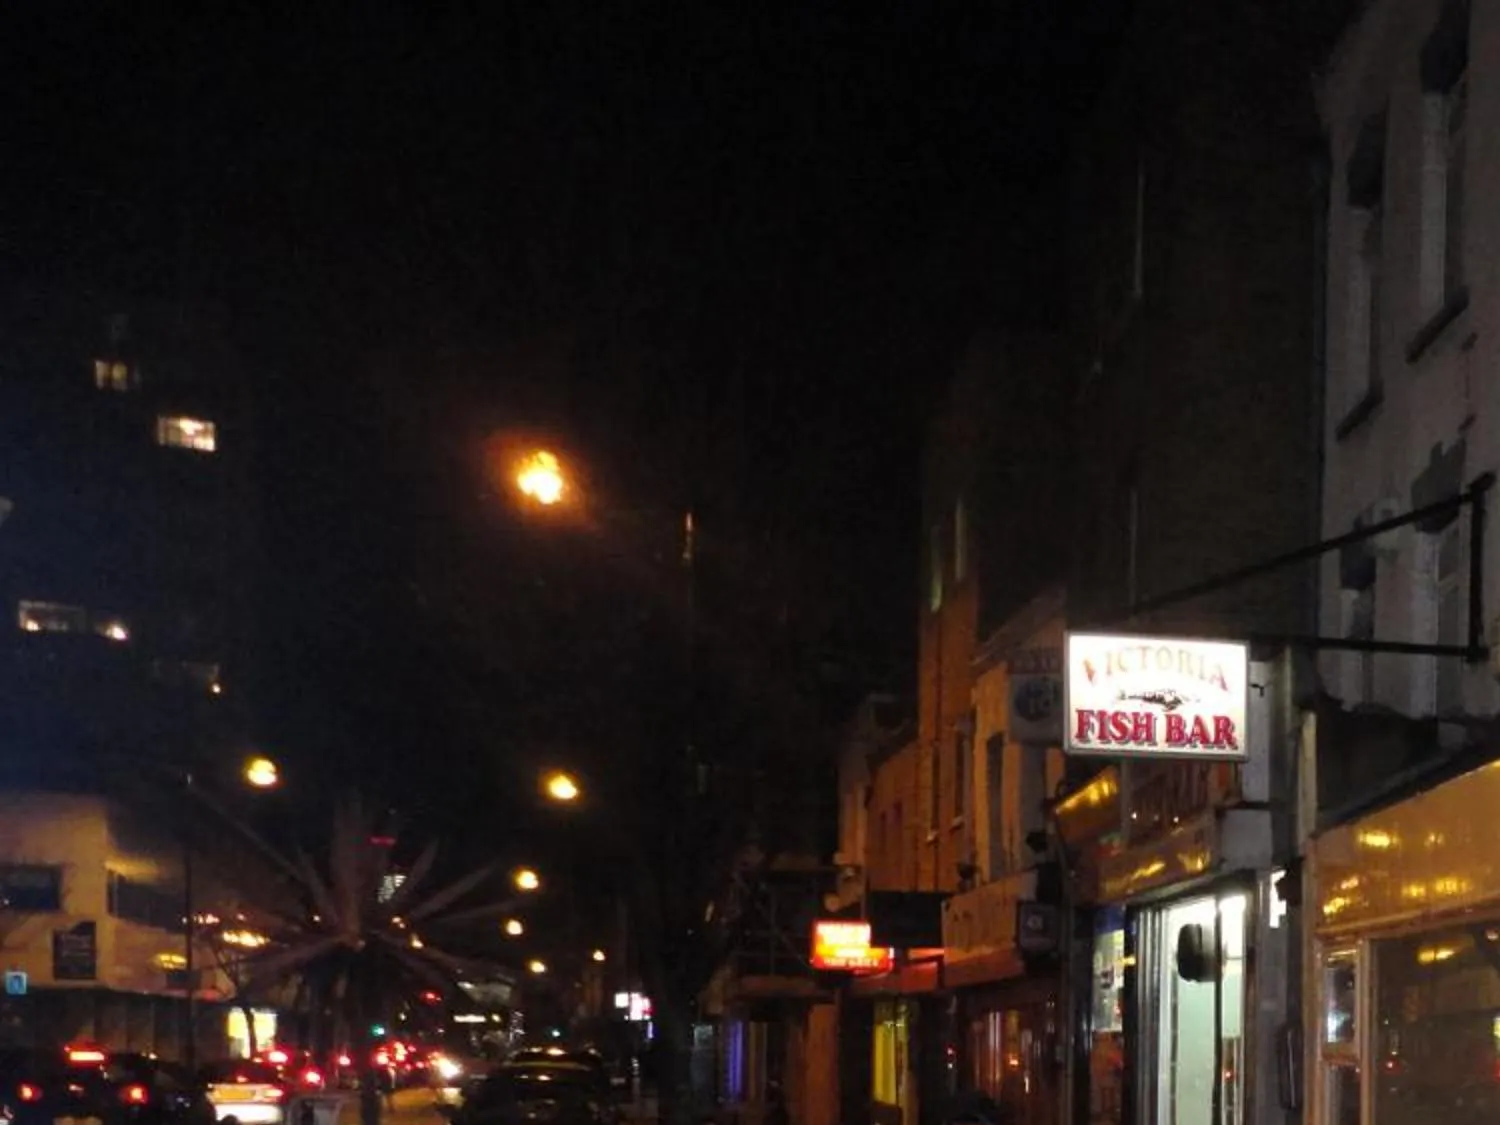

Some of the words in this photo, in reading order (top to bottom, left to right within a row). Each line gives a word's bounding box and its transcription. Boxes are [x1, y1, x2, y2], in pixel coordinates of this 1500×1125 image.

[1082, 645, 1230, 692] VICTORIA
[1075, 709, 1157, 746] FISH
[1164, 713, 1239, 750] BAR
